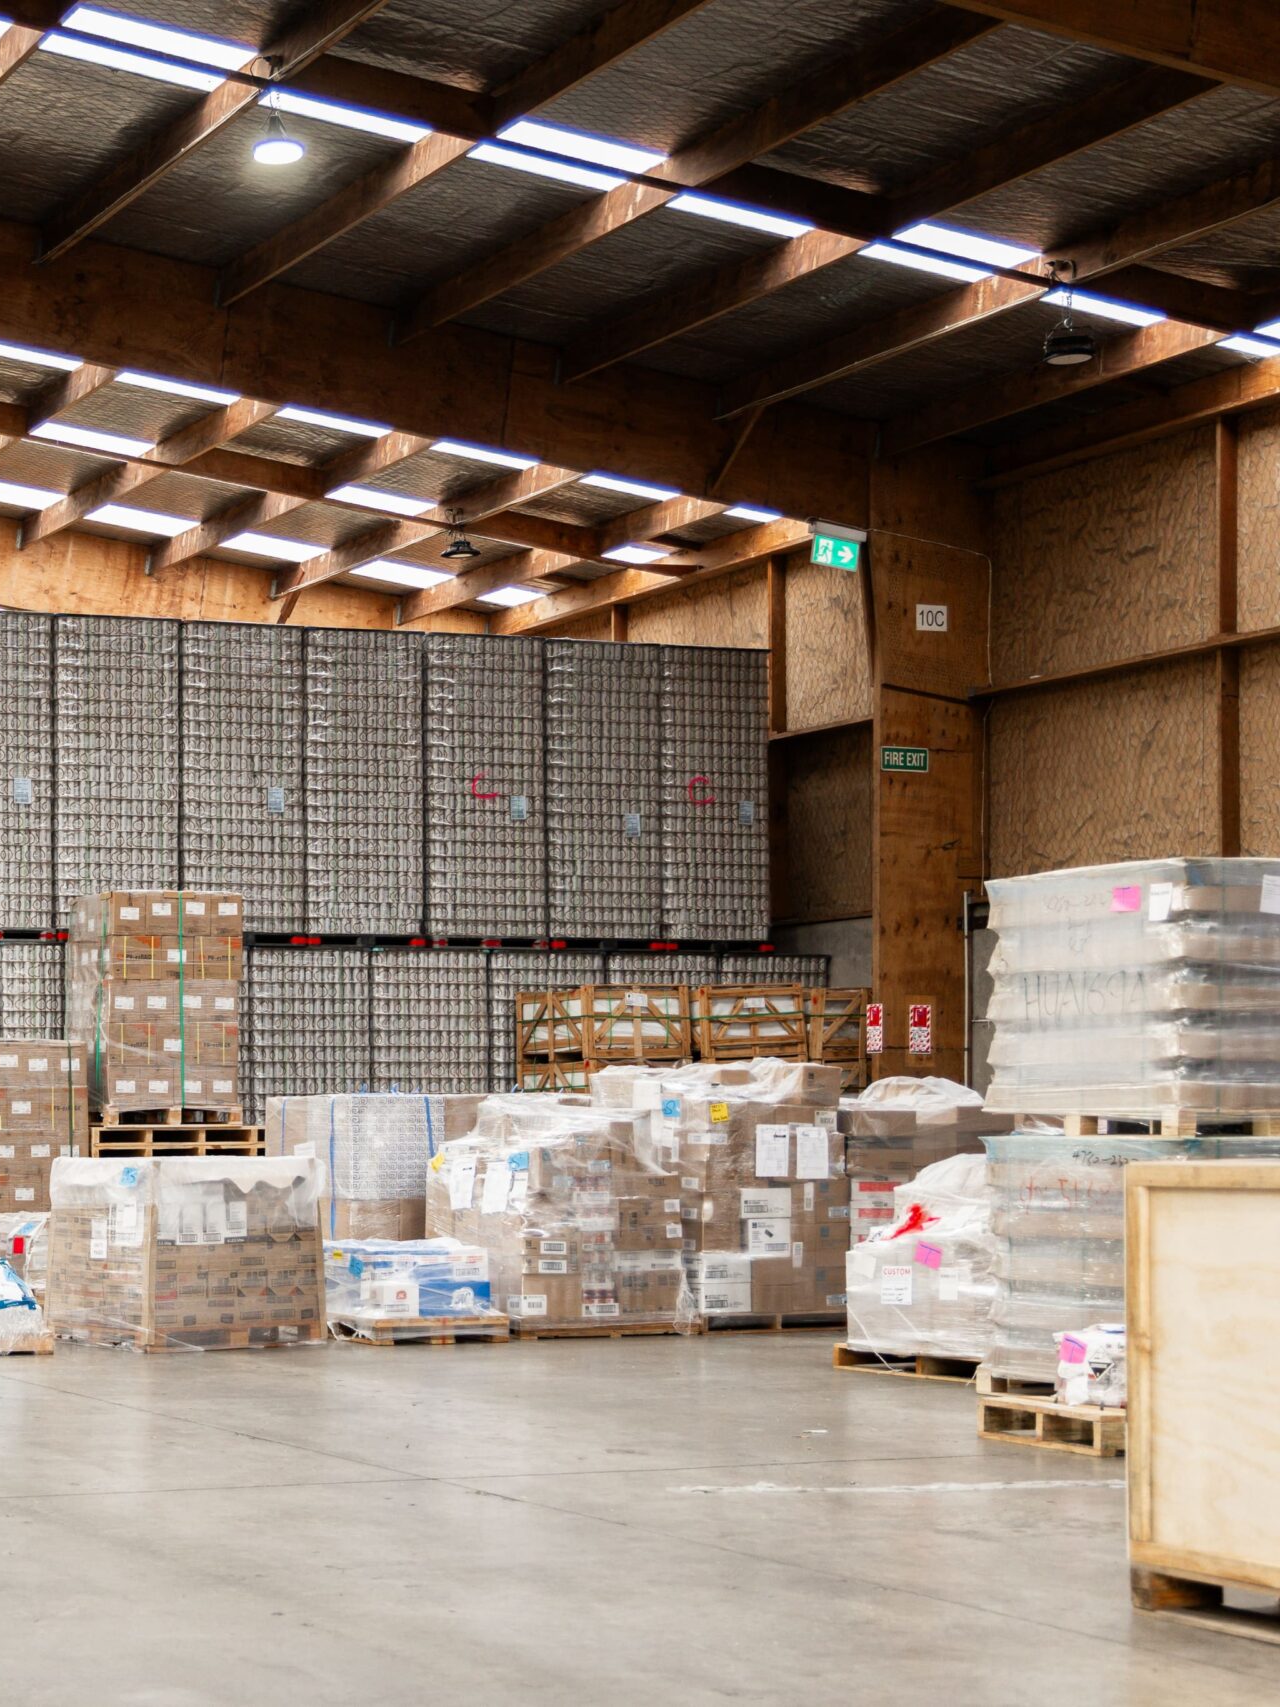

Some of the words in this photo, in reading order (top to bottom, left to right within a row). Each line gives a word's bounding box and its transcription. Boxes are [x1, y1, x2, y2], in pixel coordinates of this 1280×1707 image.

[918, 610, 945, 627] 10C
[884, 751, 904, 767] FIRE
[906, 752, 926, 768] EXIT
[882, 1267, 911, 1277] CUSTOM
